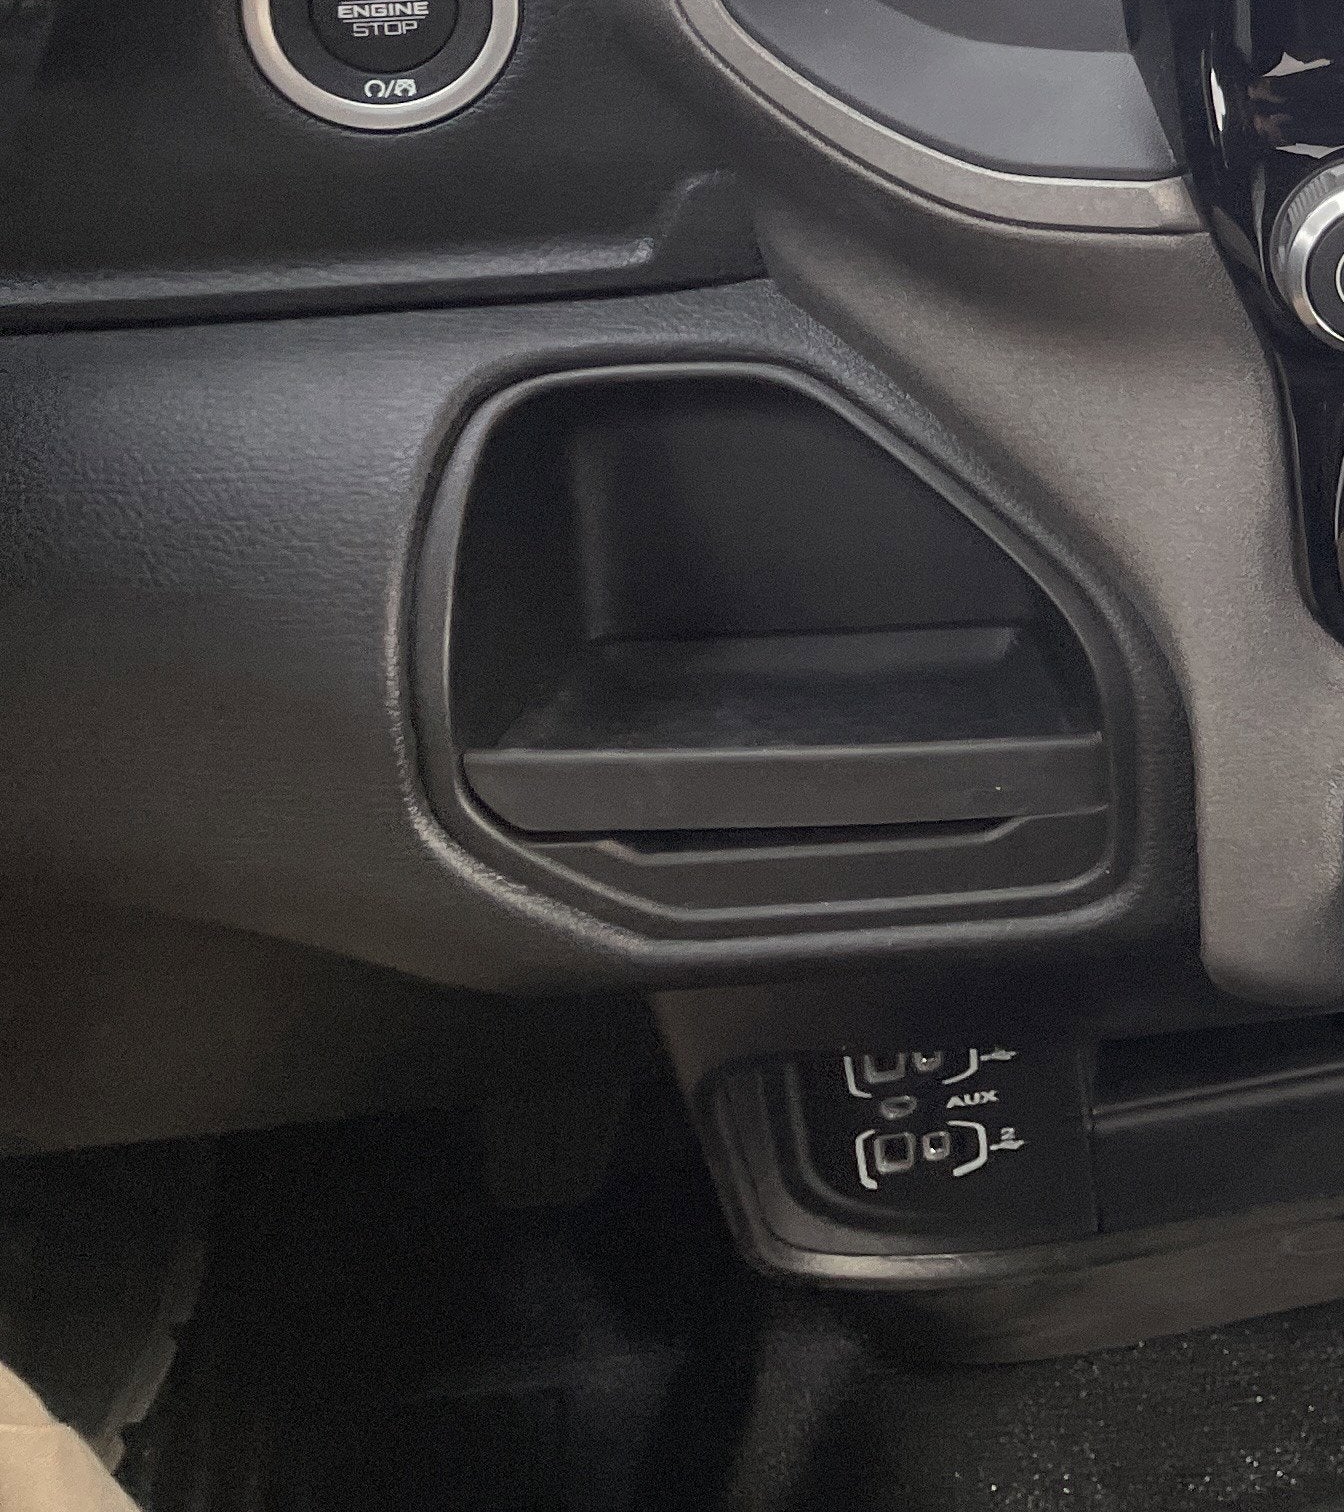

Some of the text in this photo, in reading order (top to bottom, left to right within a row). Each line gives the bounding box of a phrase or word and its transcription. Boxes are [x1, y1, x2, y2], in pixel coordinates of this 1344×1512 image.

[337, 1, 430, 19] ENGINE
[353, 20, 418, 37] STOP
[946, 1089, 1000, 1109] AUX
